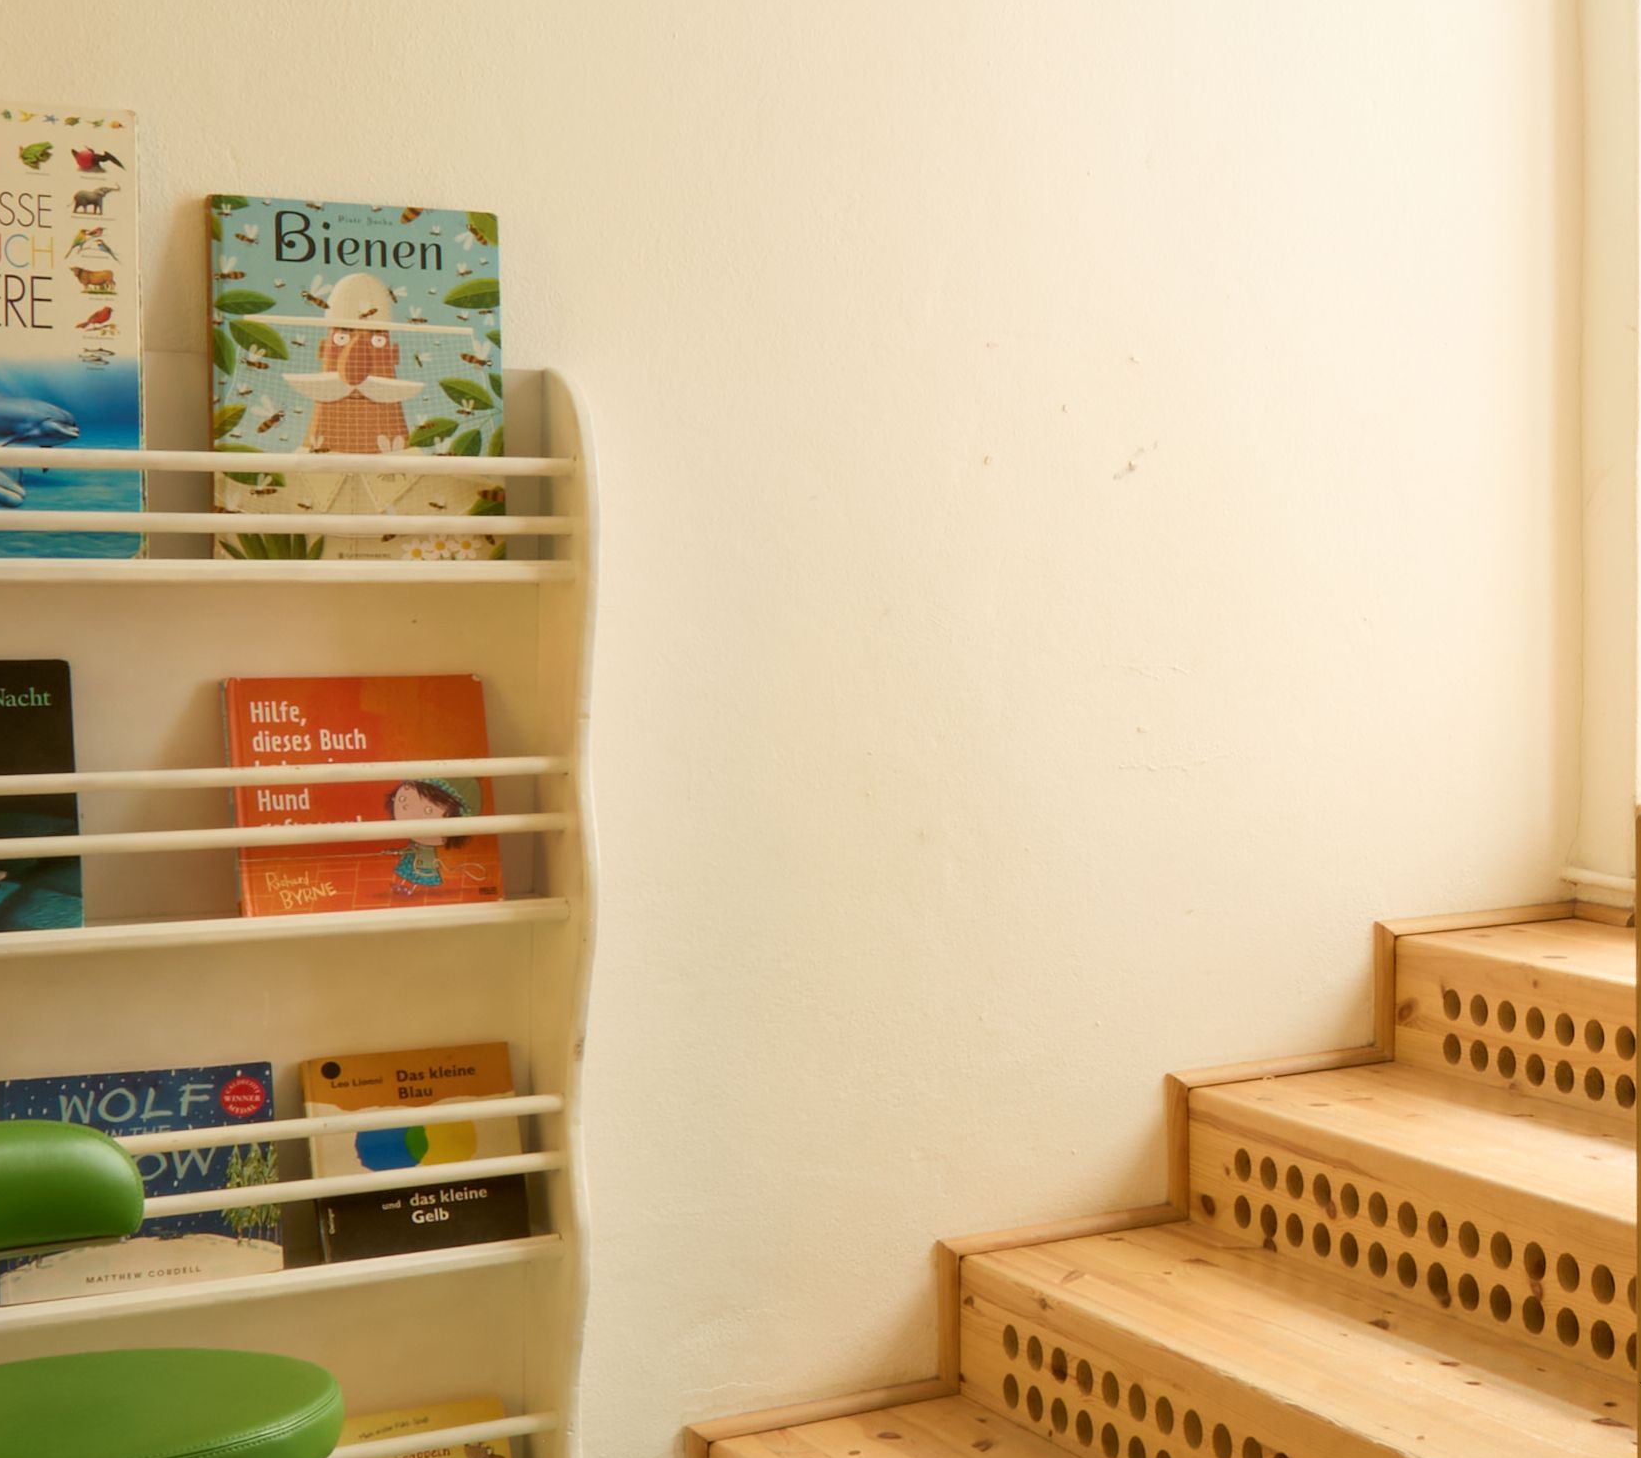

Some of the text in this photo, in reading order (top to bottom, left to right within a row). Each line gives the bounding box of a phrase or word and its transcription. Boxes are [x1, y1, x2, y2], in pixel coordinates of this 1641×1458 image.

[274, 210, 442, 271] Bienen
[249, 700, 307, 727] Hilfe,
[252, 728, 367, 753] dieses Buch
[257, 788, 311, 812] Hund
[278, 881, 338, 910] BYRNE
[331, 1079, 350, 1089] Leo
[396, 1065, 476, 1083] Das kleine
[398, 1086, 433, 1099] Blau
[59, 1084, 215, 1125] WOLF
[382, 1187, 488, 1210] und das kleine
[412, 1208, 449, 1224] Gelb
[86, 1266, 202, 1283] MATTHEW CORDELL
